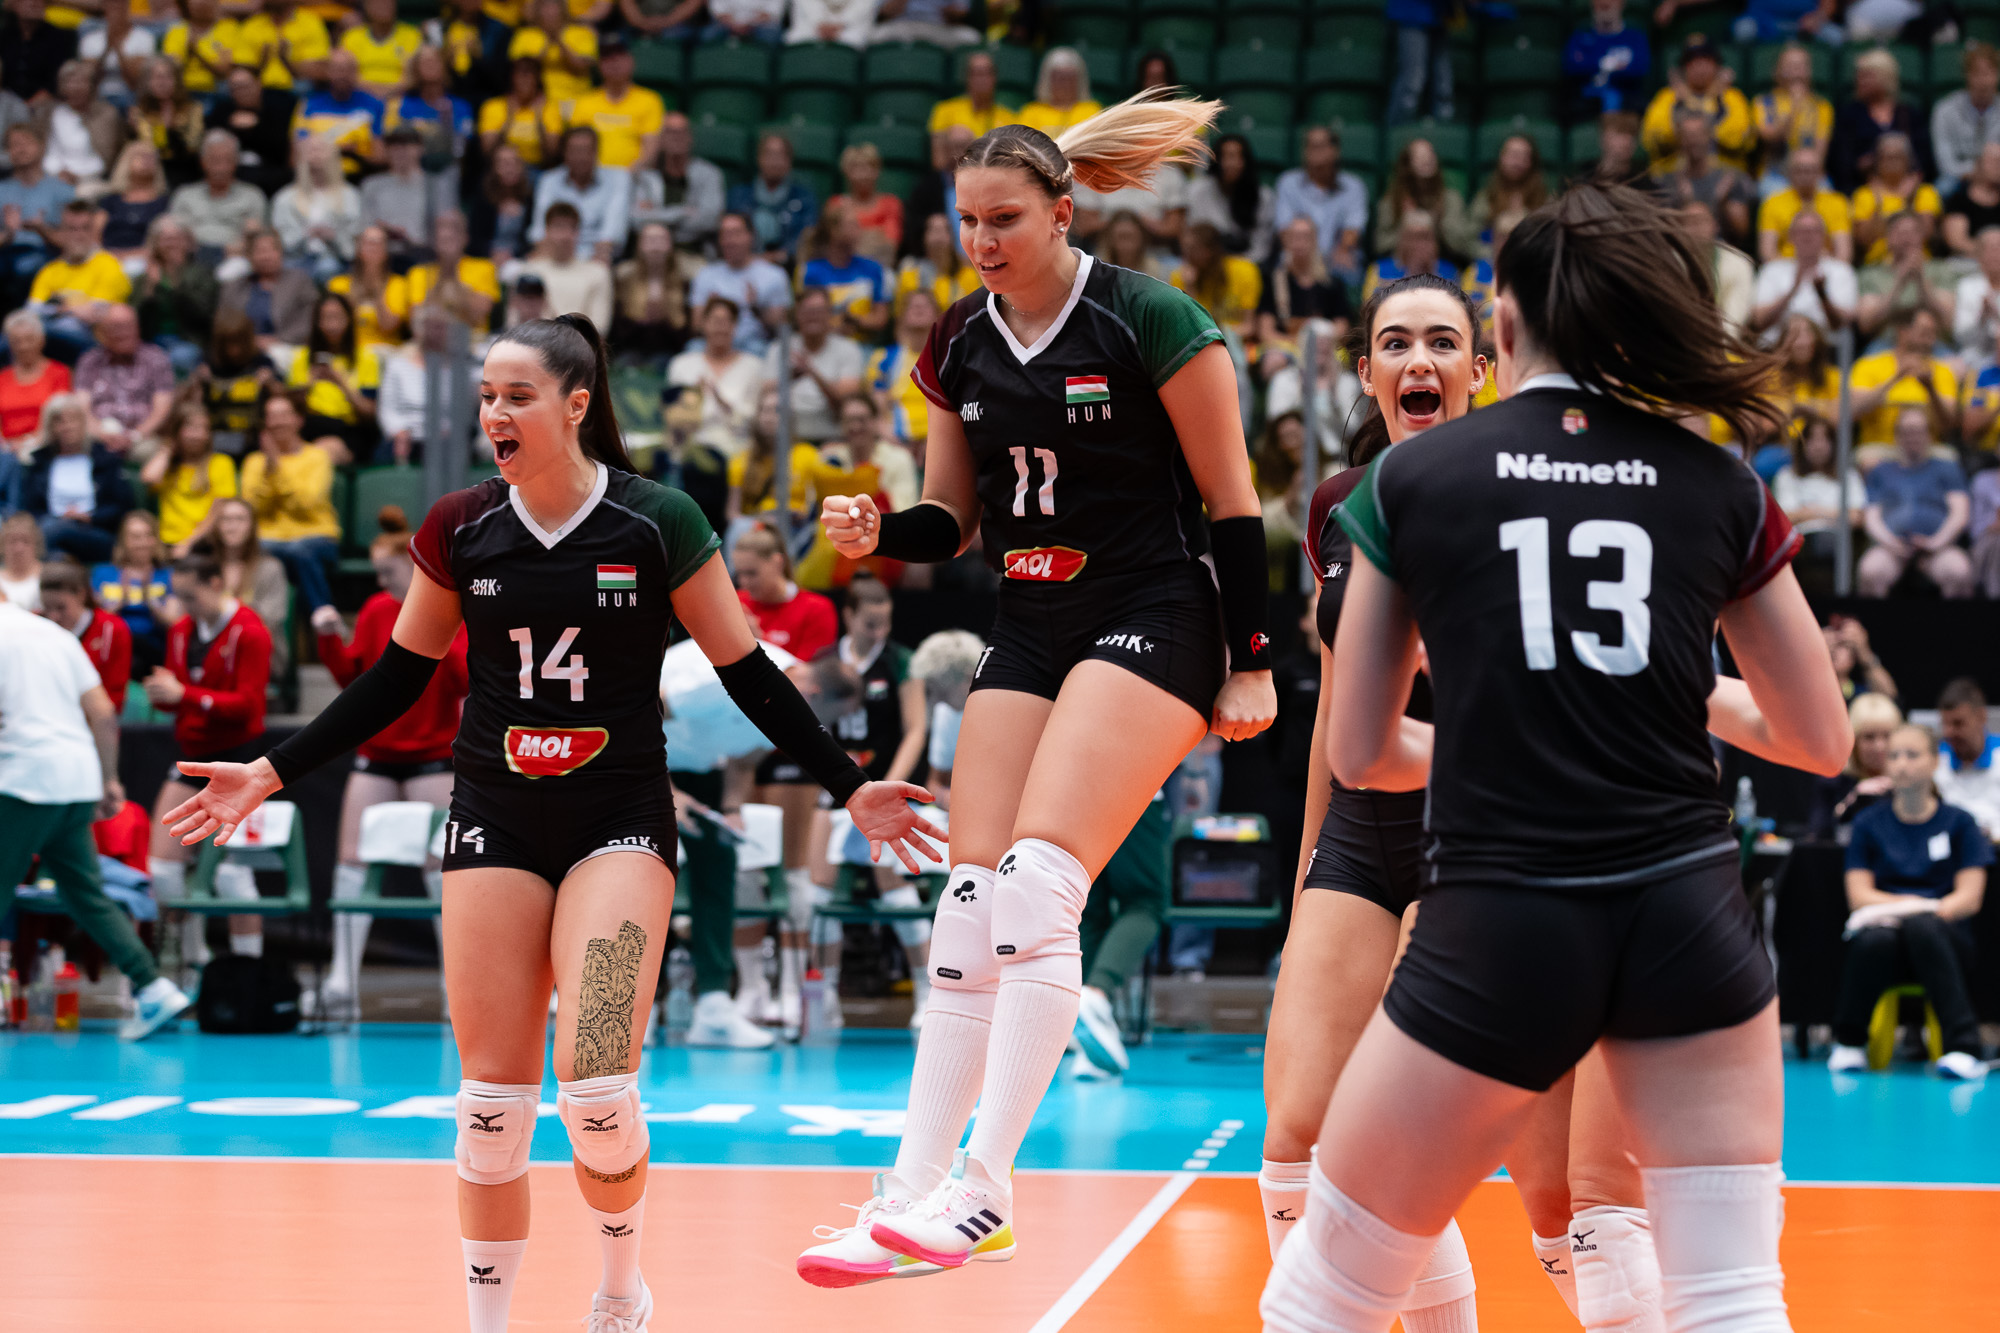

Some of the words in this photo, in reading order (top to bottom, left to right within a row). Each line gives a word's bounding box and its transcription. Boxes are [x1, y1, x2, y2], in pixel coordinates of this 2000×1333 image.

[1067, 404, 1112, 424] HUN
[1008, 446, 1059, 517] 11
[1496, 452, 1658, 487] Németh
[598, 592, 637, 607] HUN
[1499, 516, 1654, 677] 13
[508, 627, 589, 702] 14
[516, 734, 573, 759] MOL
[450, 821, 485, 855] 14
[601, 1228, 634, 1238] erima
[469, 1276, 501, 1285] erima
